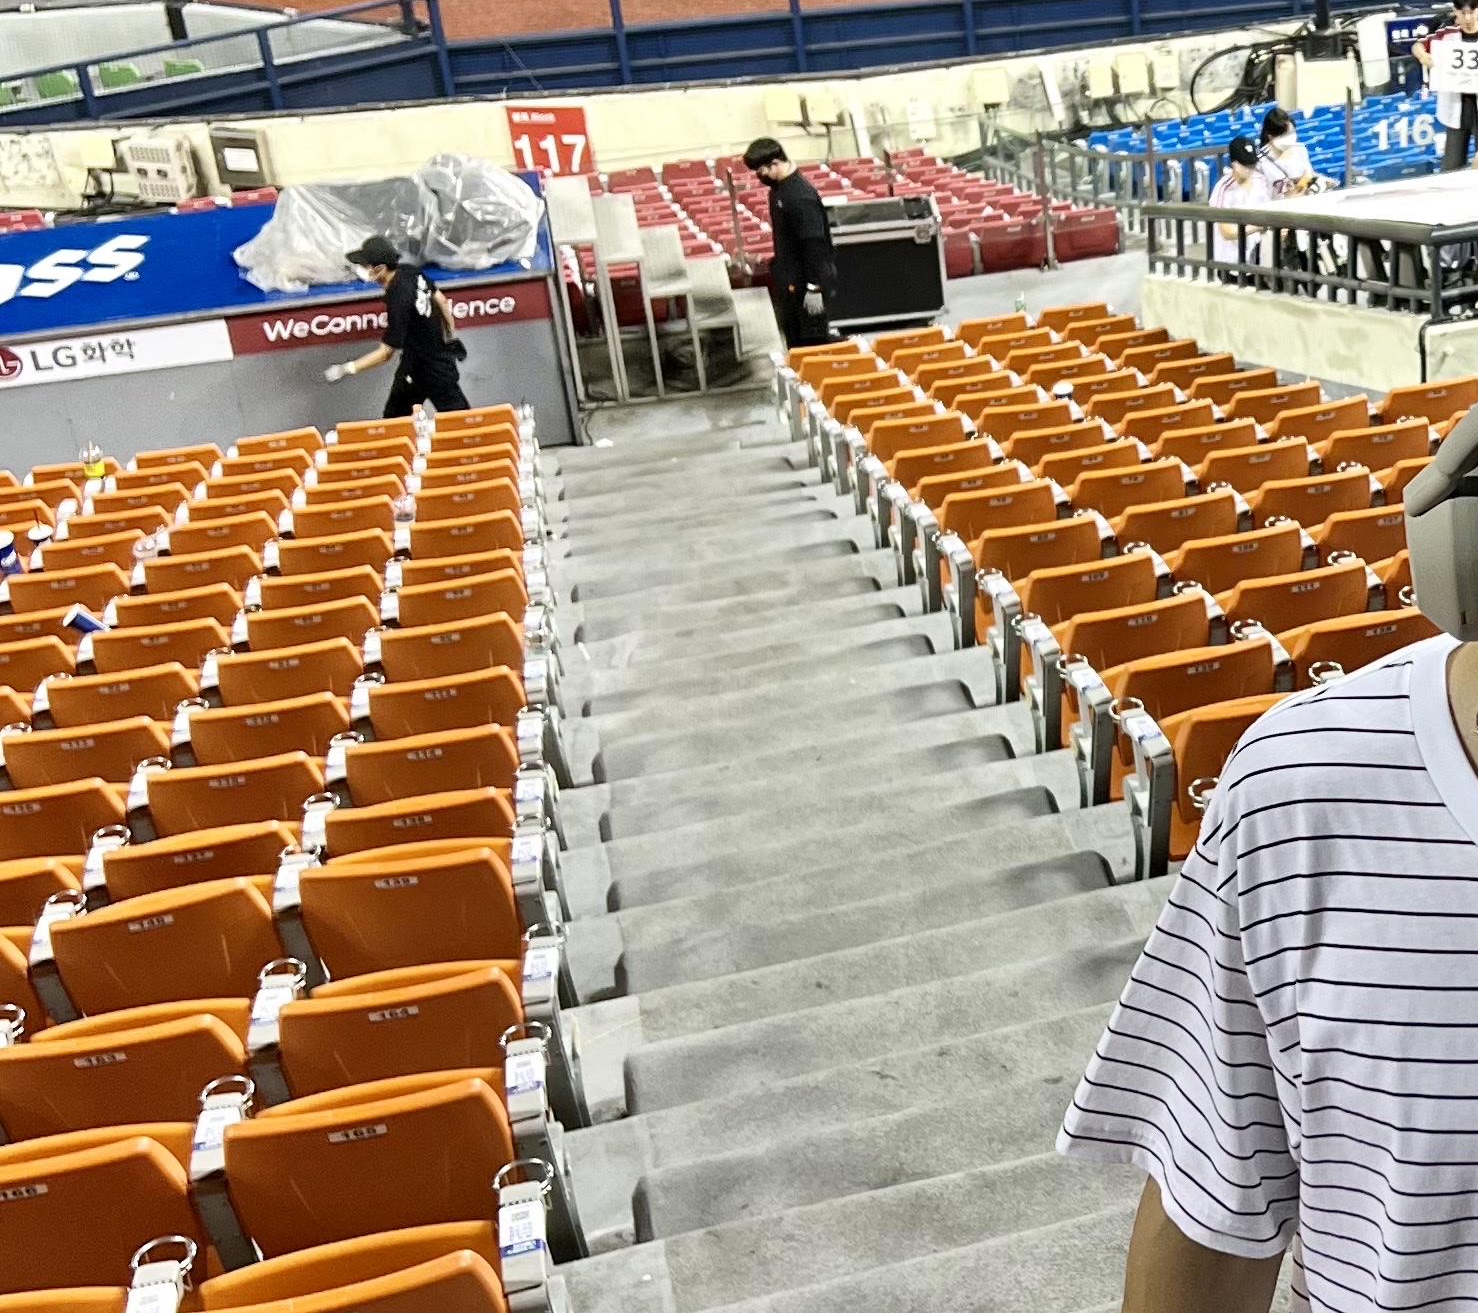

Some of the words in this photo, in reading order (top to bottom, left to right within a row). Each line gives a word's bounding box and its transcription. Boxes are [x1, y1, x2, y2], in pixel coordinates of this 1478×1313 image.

[1372, 113, 1436, 151] 116
[513, 133, 586, 174] 117
[30, 337, 136, 372] LG화학
